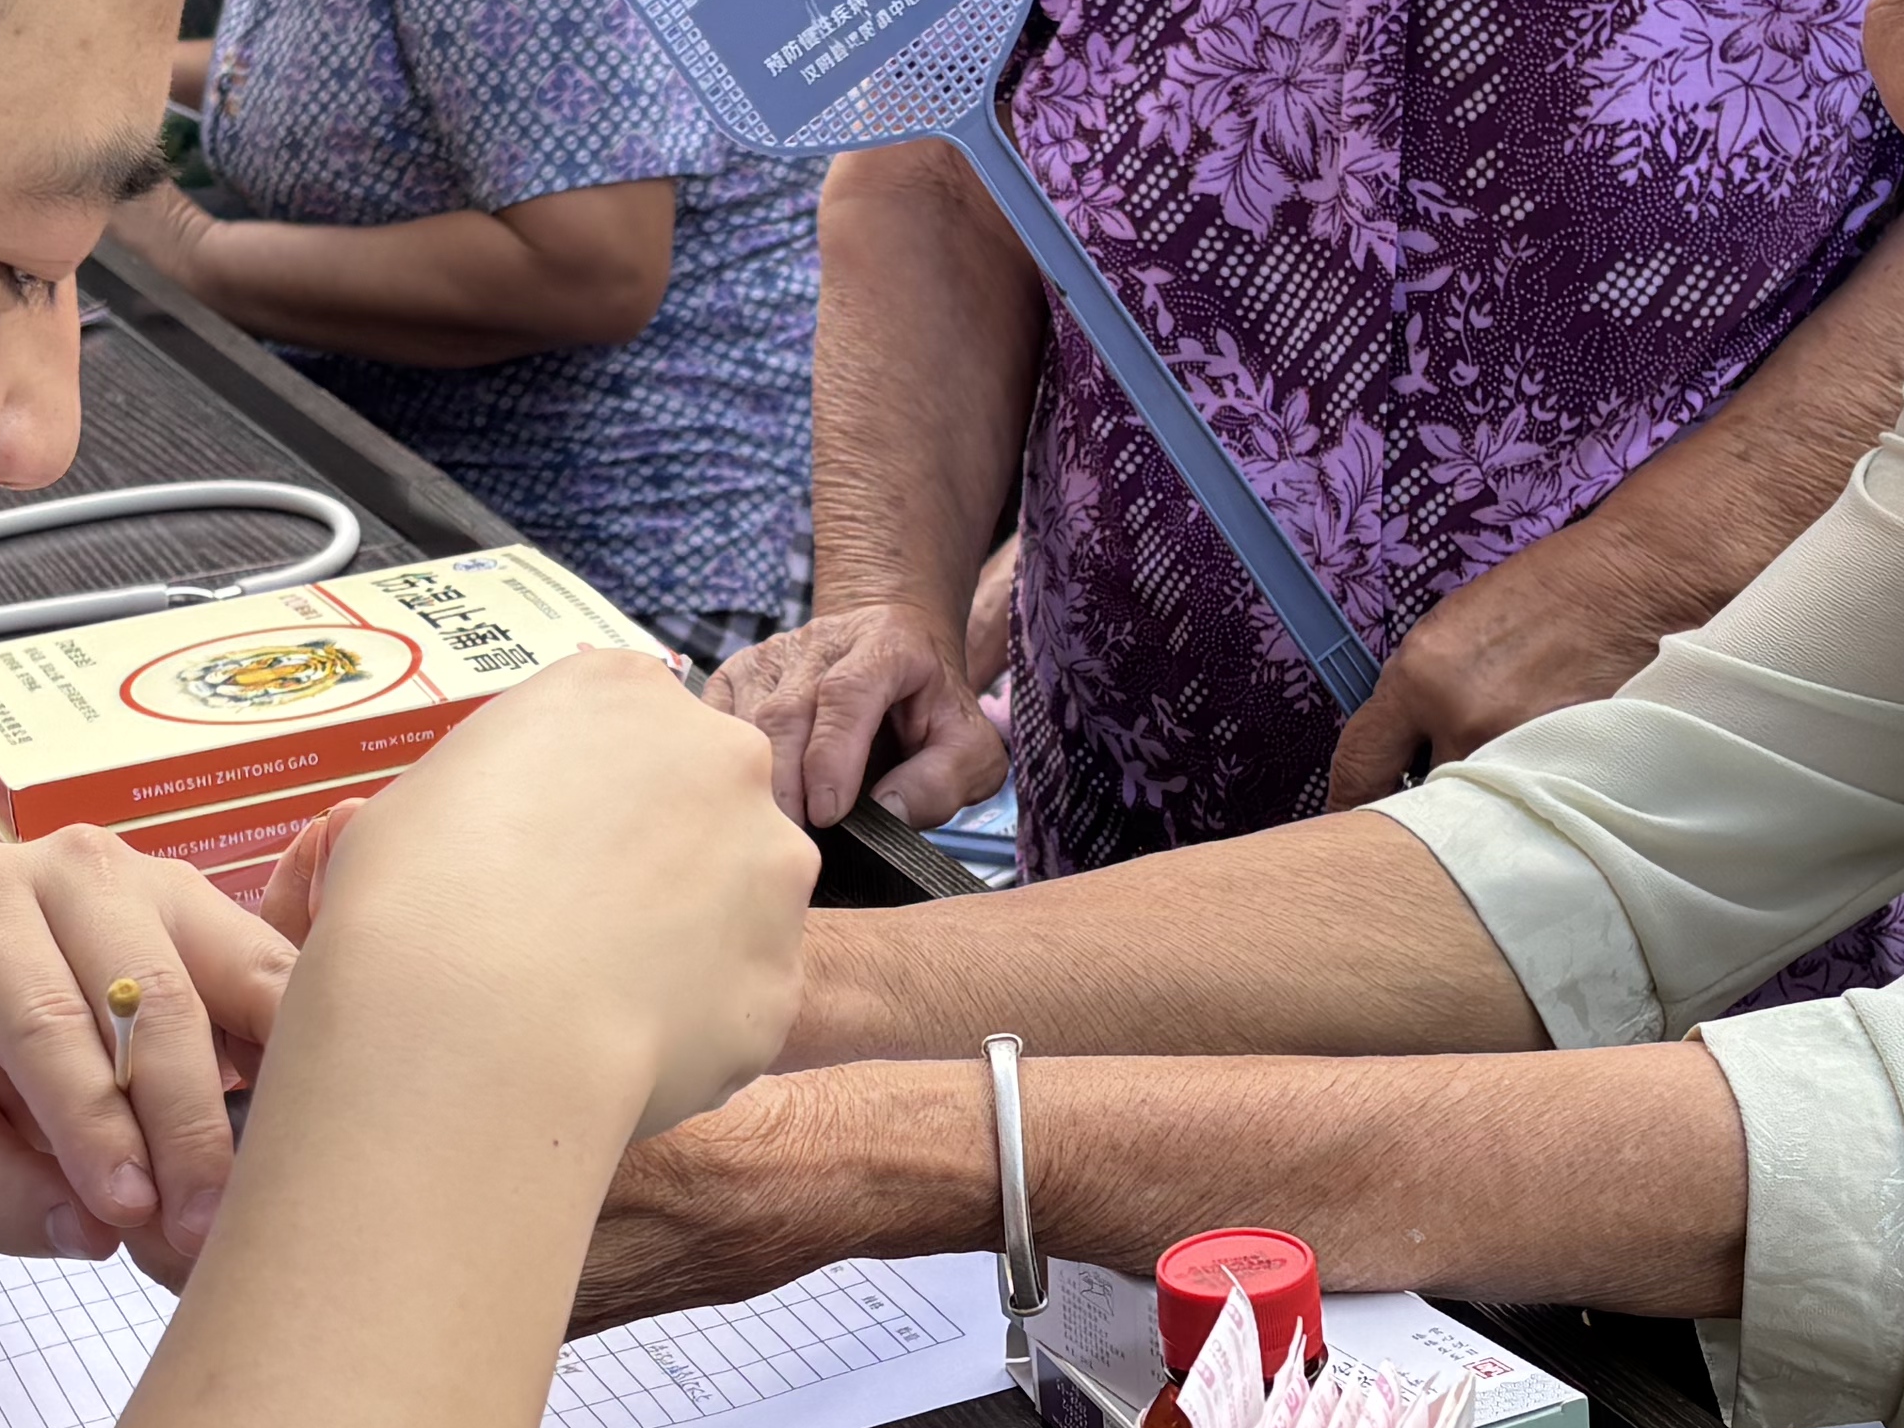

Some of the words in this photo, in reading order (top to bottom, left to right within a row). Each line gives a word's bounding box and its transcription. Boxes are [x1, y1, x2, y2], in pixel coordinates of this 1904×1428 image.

[371, 570, 541, 674] 伤湿止痛膏
[132, 774, 214, 802] SHANGSHI
[215, 759, 286, 786] ZHITONG
[288, 752, 320, 770] GAO
[218, 822, 288, 848] ZHITONG
[290, 818, 313, 834] GA
